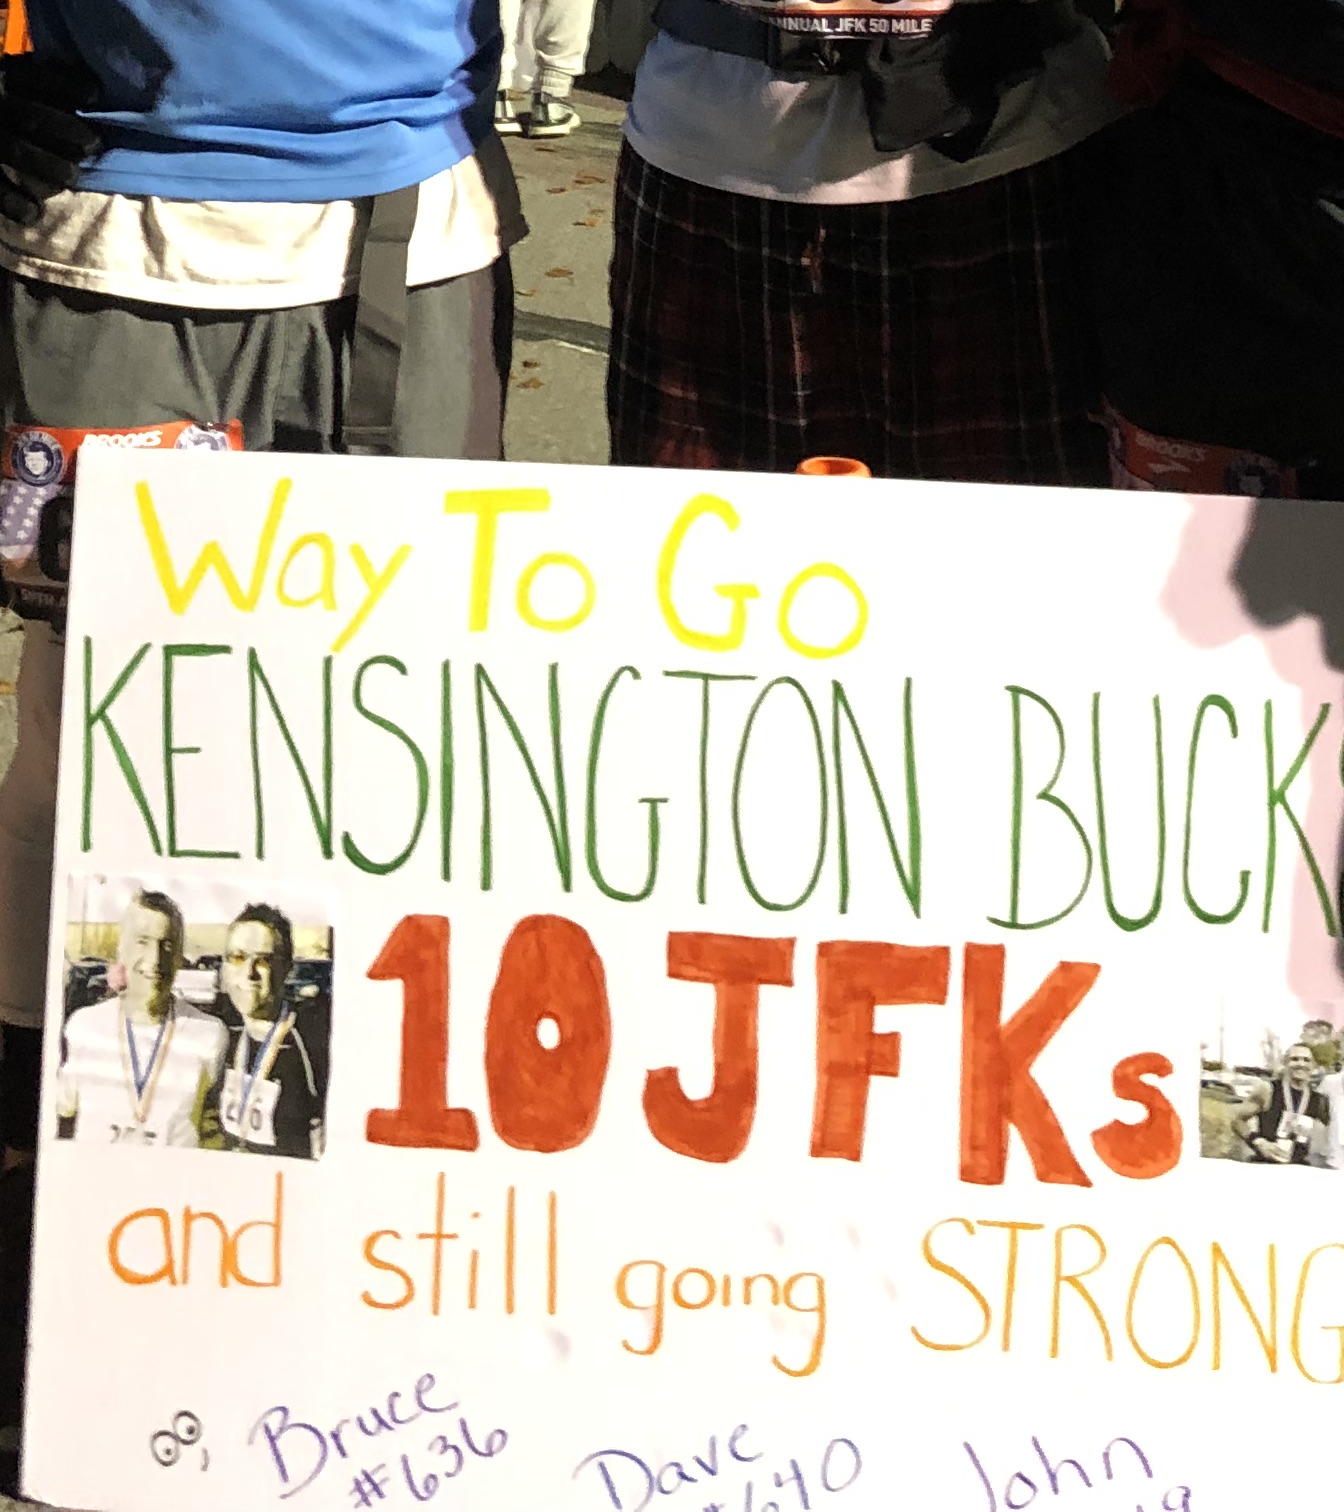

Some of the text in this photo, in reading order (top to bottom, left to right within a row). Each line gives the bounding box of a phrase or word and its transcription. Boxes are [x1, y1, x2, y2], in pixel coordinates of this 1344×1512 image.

[835, 17, 867, 34] JFK
[869, 18, 890, 34] 50
[891, 18, 933, 35] MILE
[81, 430, 164, 449] BROOKS
[134, 476, 413, 654] Way
[442, 487, 597, 635] To
[655, 492, 871, 661] Go
[81, 635, 923, 914] KENSINGTON
[106, 1172, 285, 1289] and
[360, 1172, 559, 1317] still
[613, 1258, 828, 1378] going
[247, 1372, 460, 1500] Bruce
[348, 1418, 509, 1508] #636
[573, 1423, 764, 1512] Dave
[961, 1433, 1154, 1512] John
